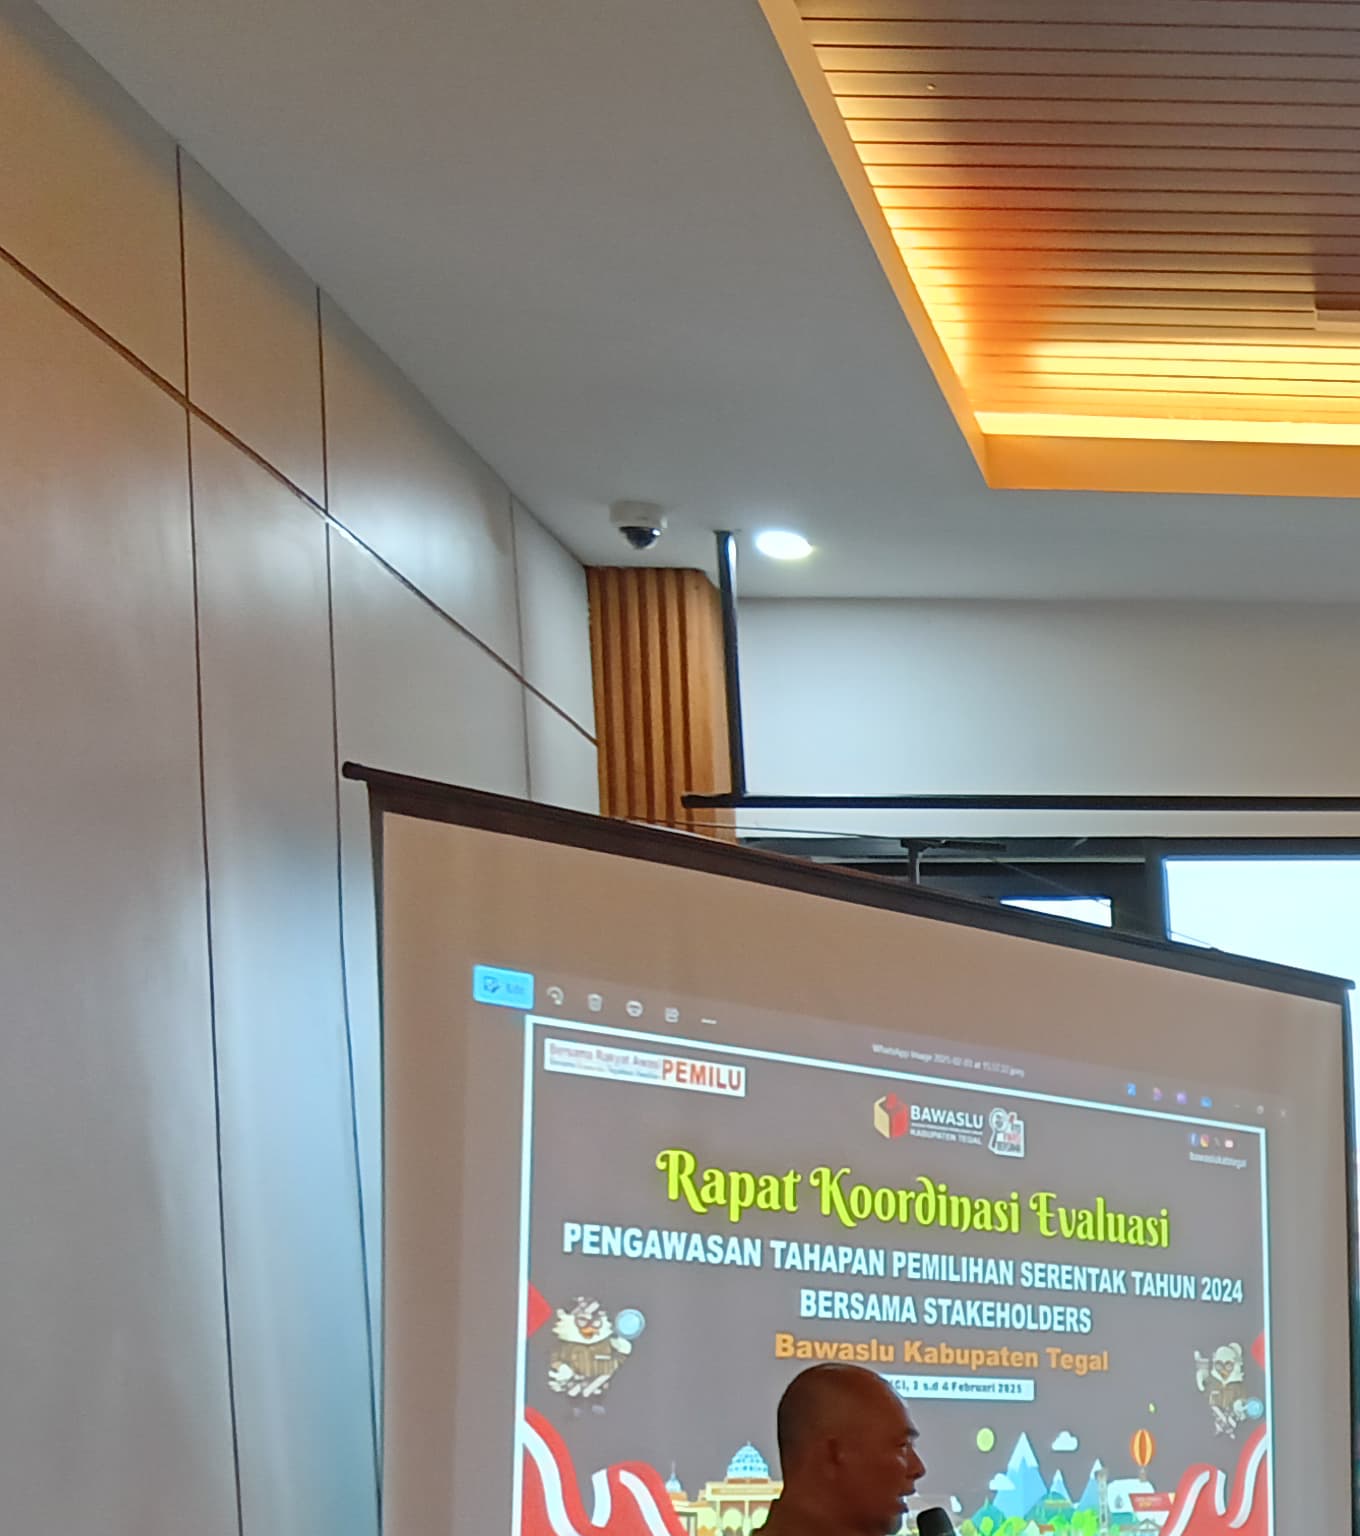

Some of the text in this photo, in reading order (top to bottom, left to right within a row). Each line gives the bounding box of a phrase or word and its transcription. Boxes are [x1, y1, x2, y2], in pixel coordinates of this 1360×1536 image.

[661, 1058, 743, 1091] PEMILU
[909, 1103, 984, 1131] BAWASLU
[654, 1147, 1170, 1249] Rapat Koordinasi Evaluasi
[562, 1220, 1244, 1305] PENGAWASAN TAHAPAN PEMILIHAN SERENTAK TAHUN 2024
[799, 1287, 1092, 1334] BERSAMA STAKEHOLDERS
[774, 1332, 1109, 1376] Bawaslu Kabupaten Tegal
[951, 1382, 996, 1393] Februari
